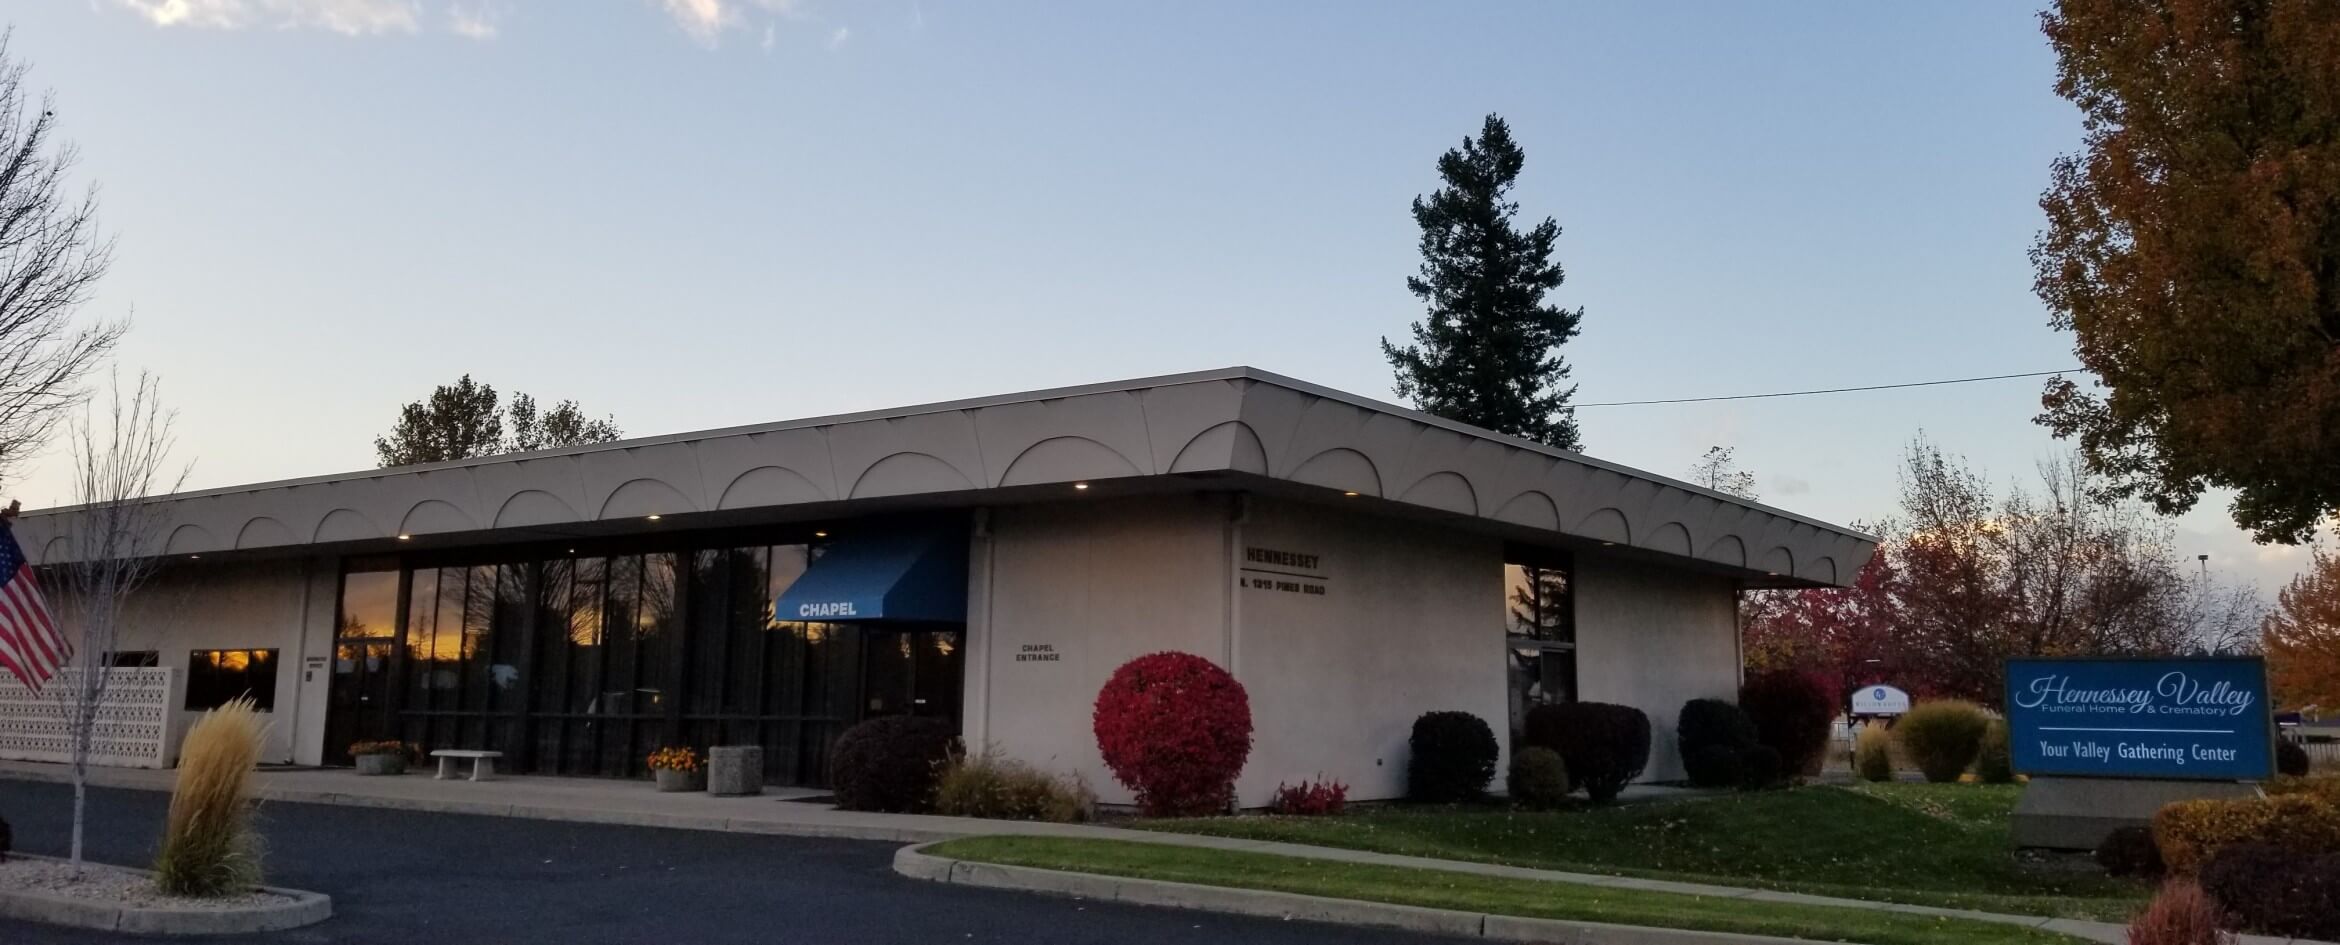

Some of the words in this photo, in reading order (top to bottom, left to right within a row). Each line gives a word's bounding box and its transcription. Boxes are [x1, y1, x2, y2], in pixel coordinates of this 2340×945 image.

[1247, 547, 1319, 569] HENNESSEY
[1276, 581, 1300, 593] PINES
[1304, 585, 1325, 595] ROAD
[800, 601, 857, 617] CHAPEL
[1023, 644, 1053, 652] CHAPEL
[1016, 653, 1060, 662] ENTRANCE
[2015, 674, 2154, 714] Hennessey
[2156, 671, 2255, 716] Valley
[2041, 704, 2086, 713] Funeral
[2090, 704, 2126, 714] Home
[2147, 704, 2156, 714] &
[2160, 704, 2227, 716] Crematory
[2040, 741, 2069, 758] Your
[2072, 741, 2110, 763] Valley
[2117, 742, 2185, 765] Gathering
[2191, 744, 2237, 762] Center
